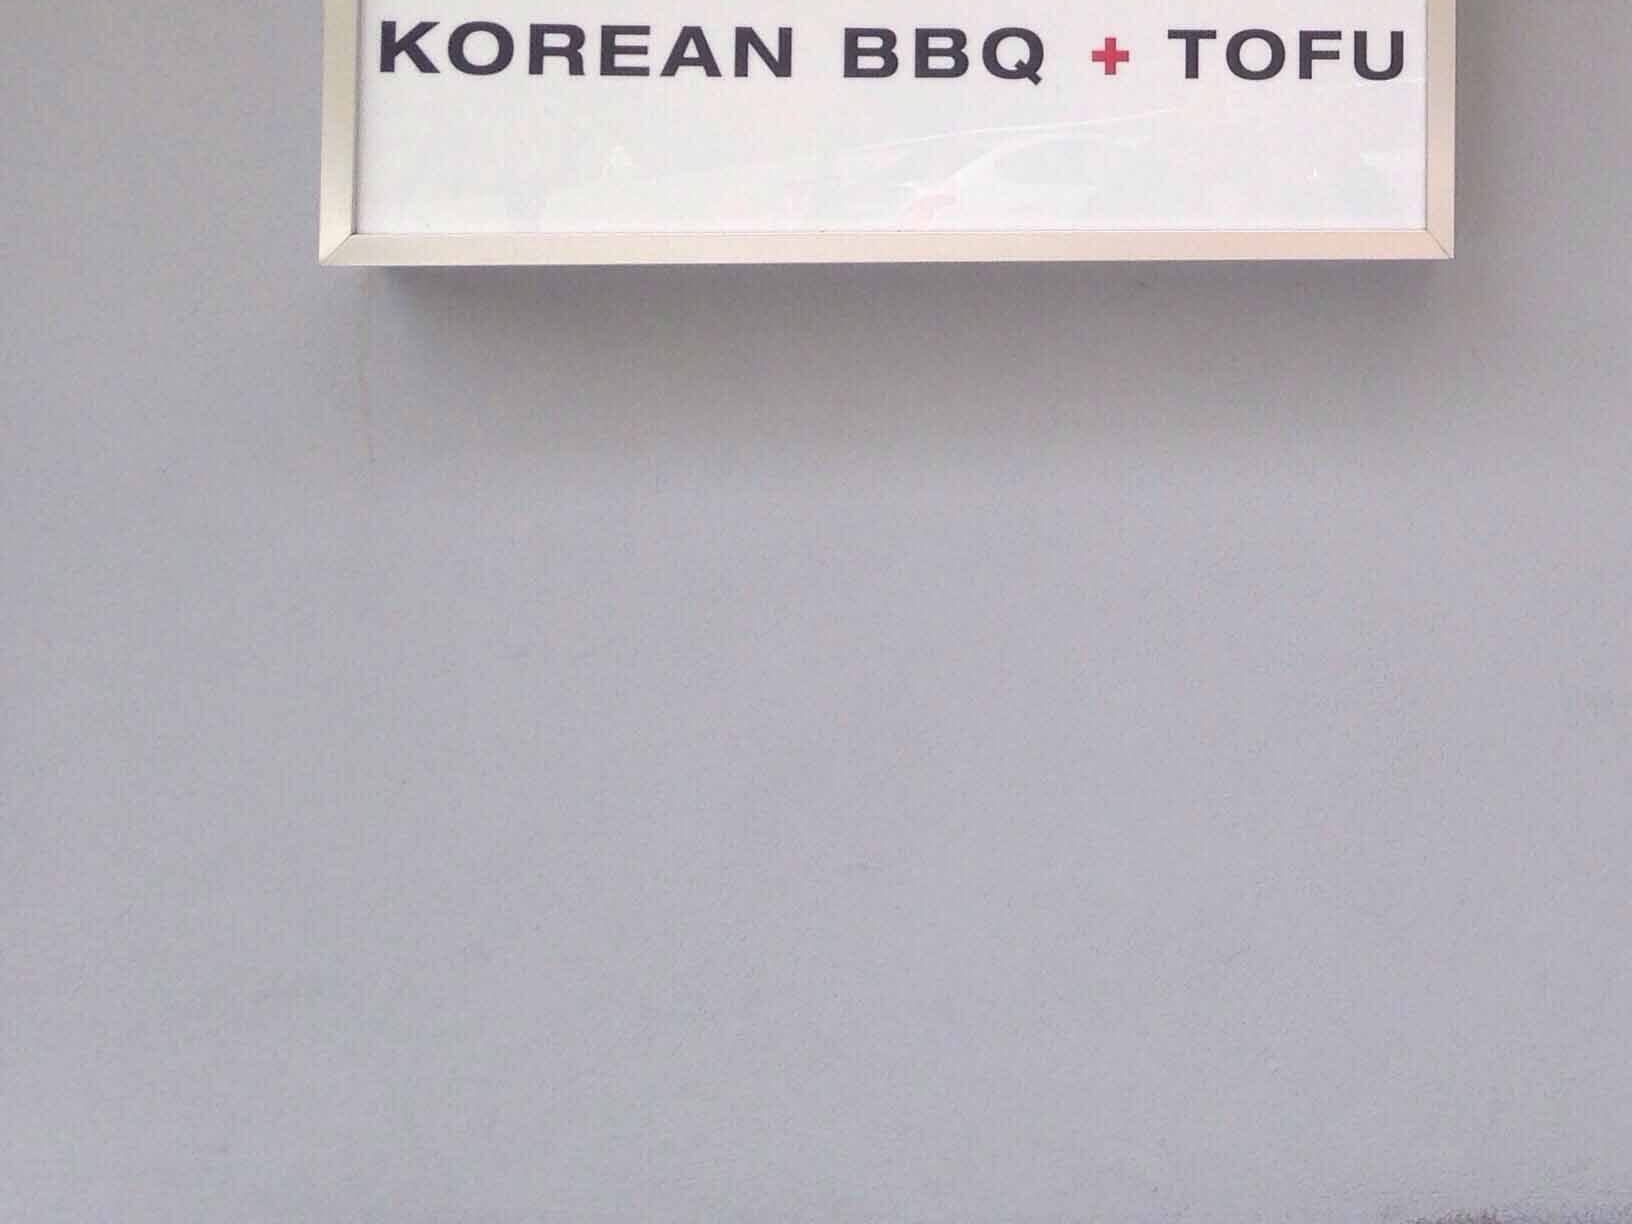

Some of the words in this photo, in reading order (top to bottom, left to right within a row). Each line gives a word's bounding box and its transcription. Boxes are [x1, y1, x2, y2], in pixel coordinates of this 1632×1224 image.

[380, 21, 792, 78] KOREAN
[843, 27, 1045, 85] BBQ
[1168, 29, 1404, 80] TOFU
